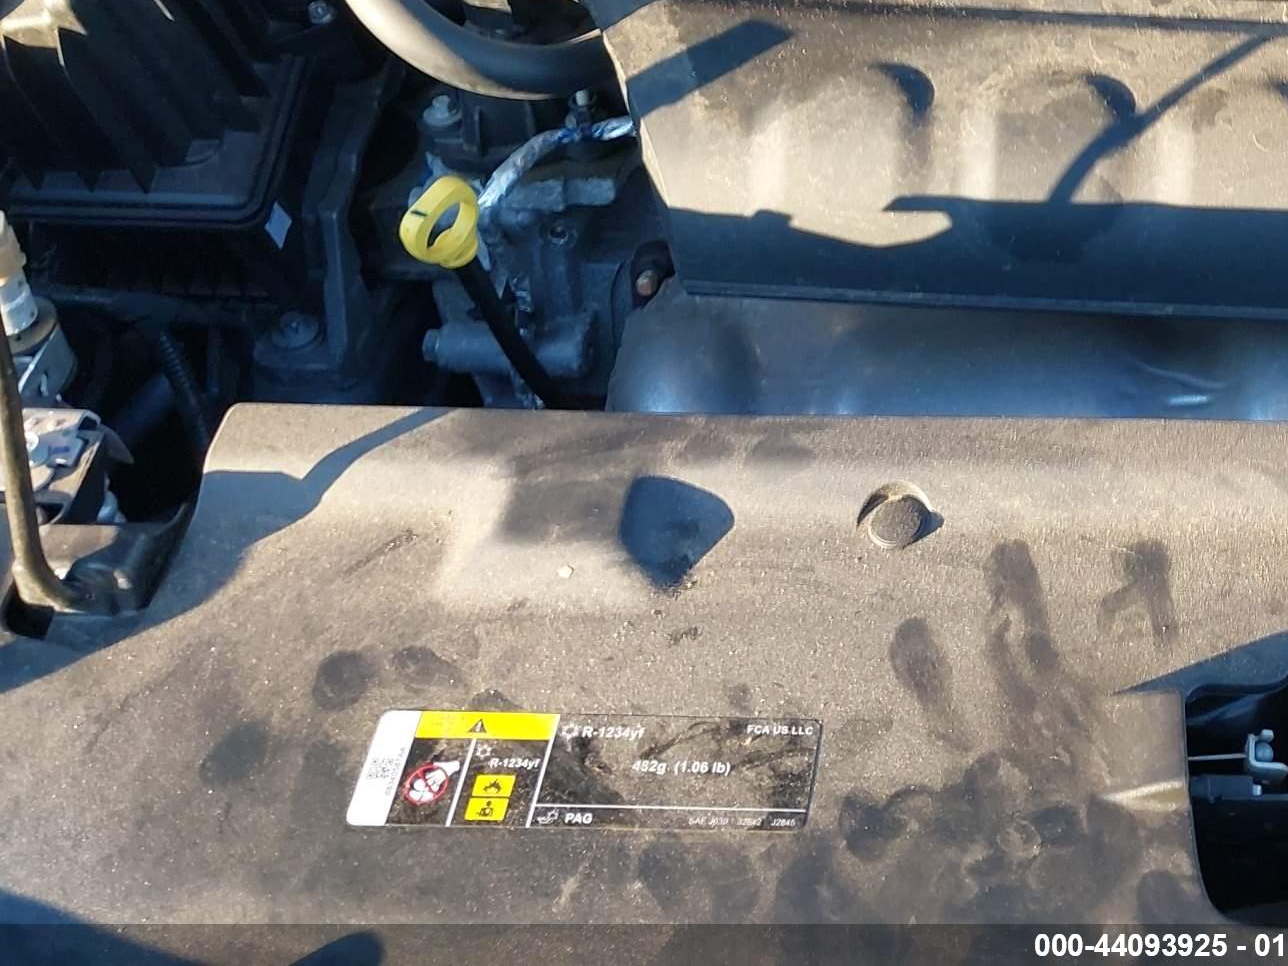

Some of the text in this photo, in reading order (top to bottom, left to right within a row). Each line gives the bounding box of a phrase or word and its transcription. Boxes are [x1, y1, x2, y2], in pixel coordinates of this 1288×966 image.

[582, 725, 646, 740] R-1234yf
[746, 724, 814, 736] FCA US LLC
[488, 757, 541, 770] R-1234yf
[673, 760, 709, 776] (1.06
[711, 761, 731, 777] lb)
[563, 812, 594, 825] PAG
